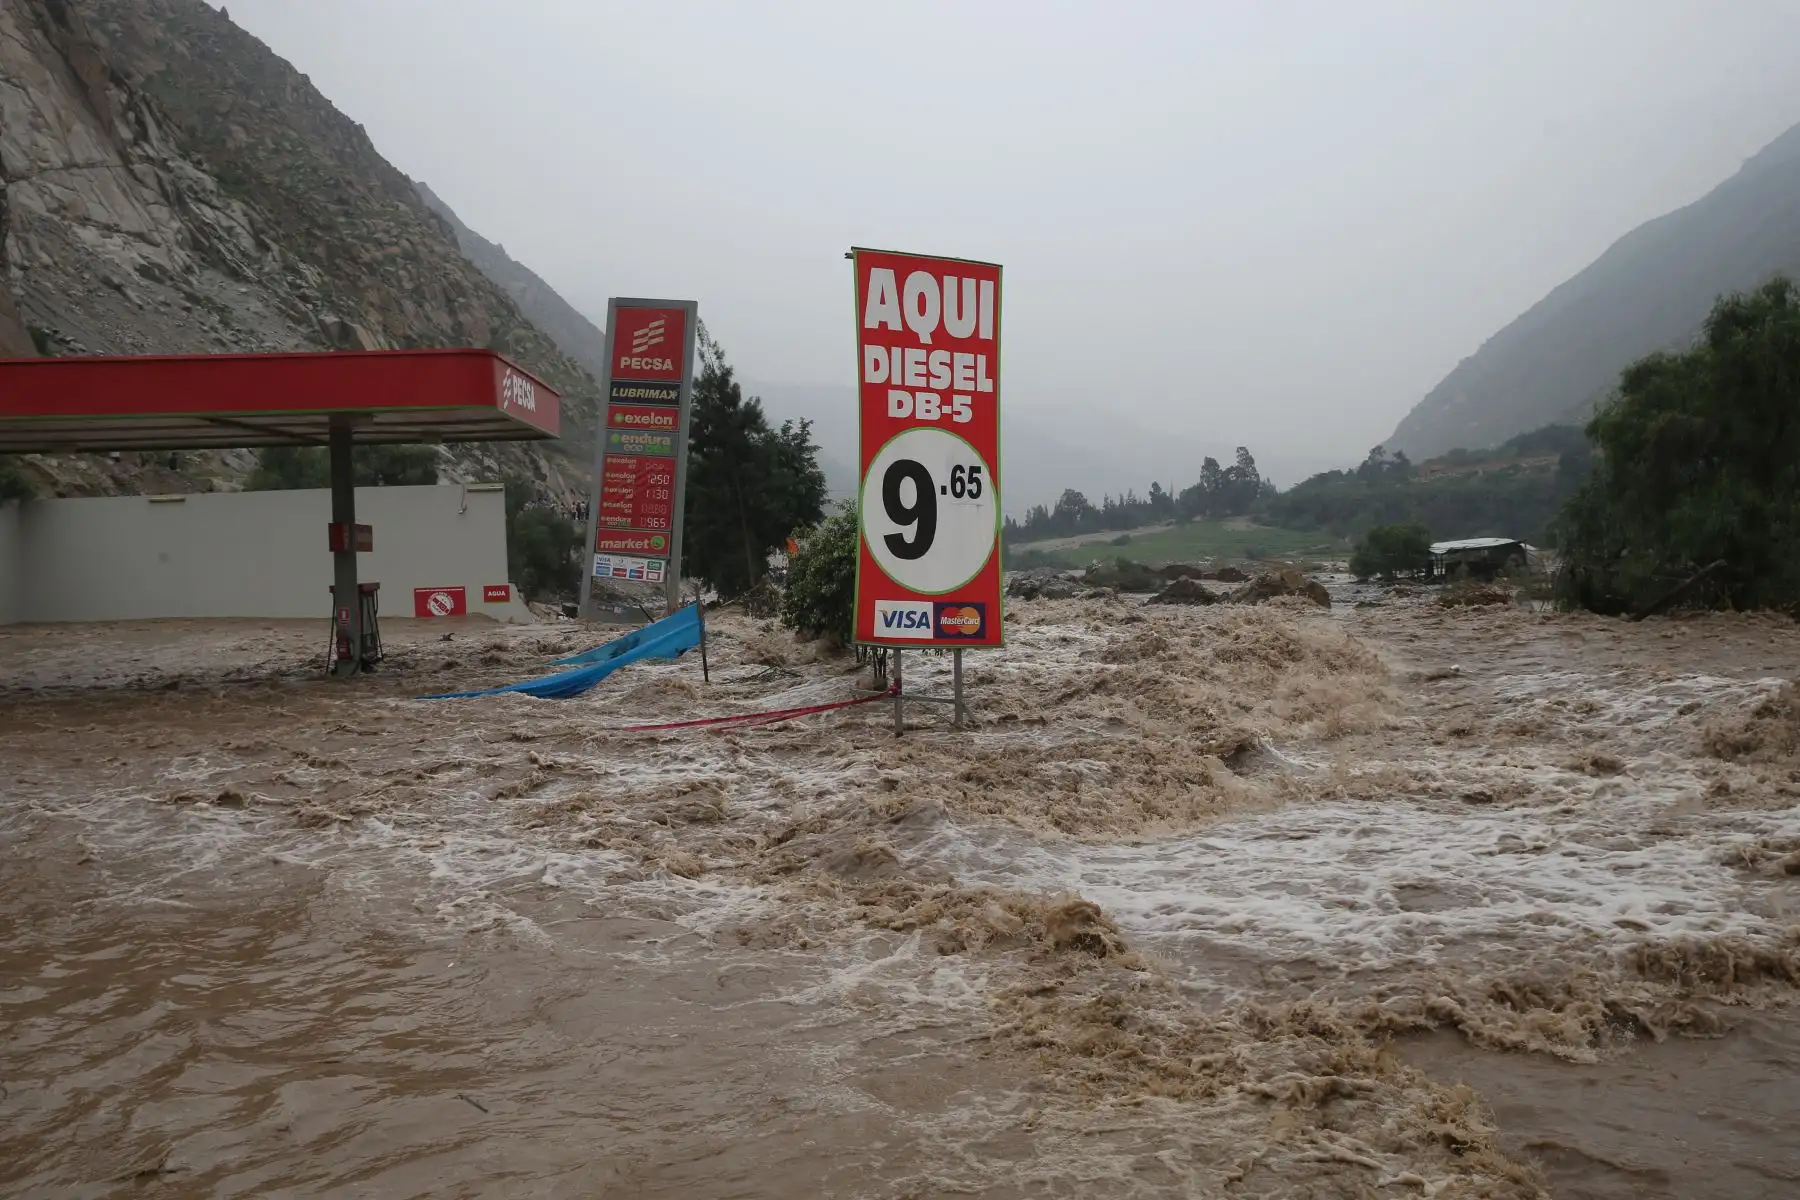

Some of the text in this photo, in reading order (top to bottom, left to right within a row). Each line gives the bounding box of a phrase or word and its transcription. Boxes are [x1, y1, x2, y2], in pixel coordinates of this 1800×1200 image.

[864, 267, 994, 344] AQUI
[621, 357, 673, 370] PECSA
[864, 344, 993, 392] DIESEL
[513, 375, 535, 412] PECSA
[612, 388, 677, 399] LUBRIMAX
[888, 389, 973, 423] DB-5
[625, 412, 673, 425] exelon
[622, 433, 671, 445] endura
[624, 444, 643, 452] eco
[600, 538, 650, 550] market
[880, 609, 931, 629] VISA
[939, 614, 981, 626] MasterCard
